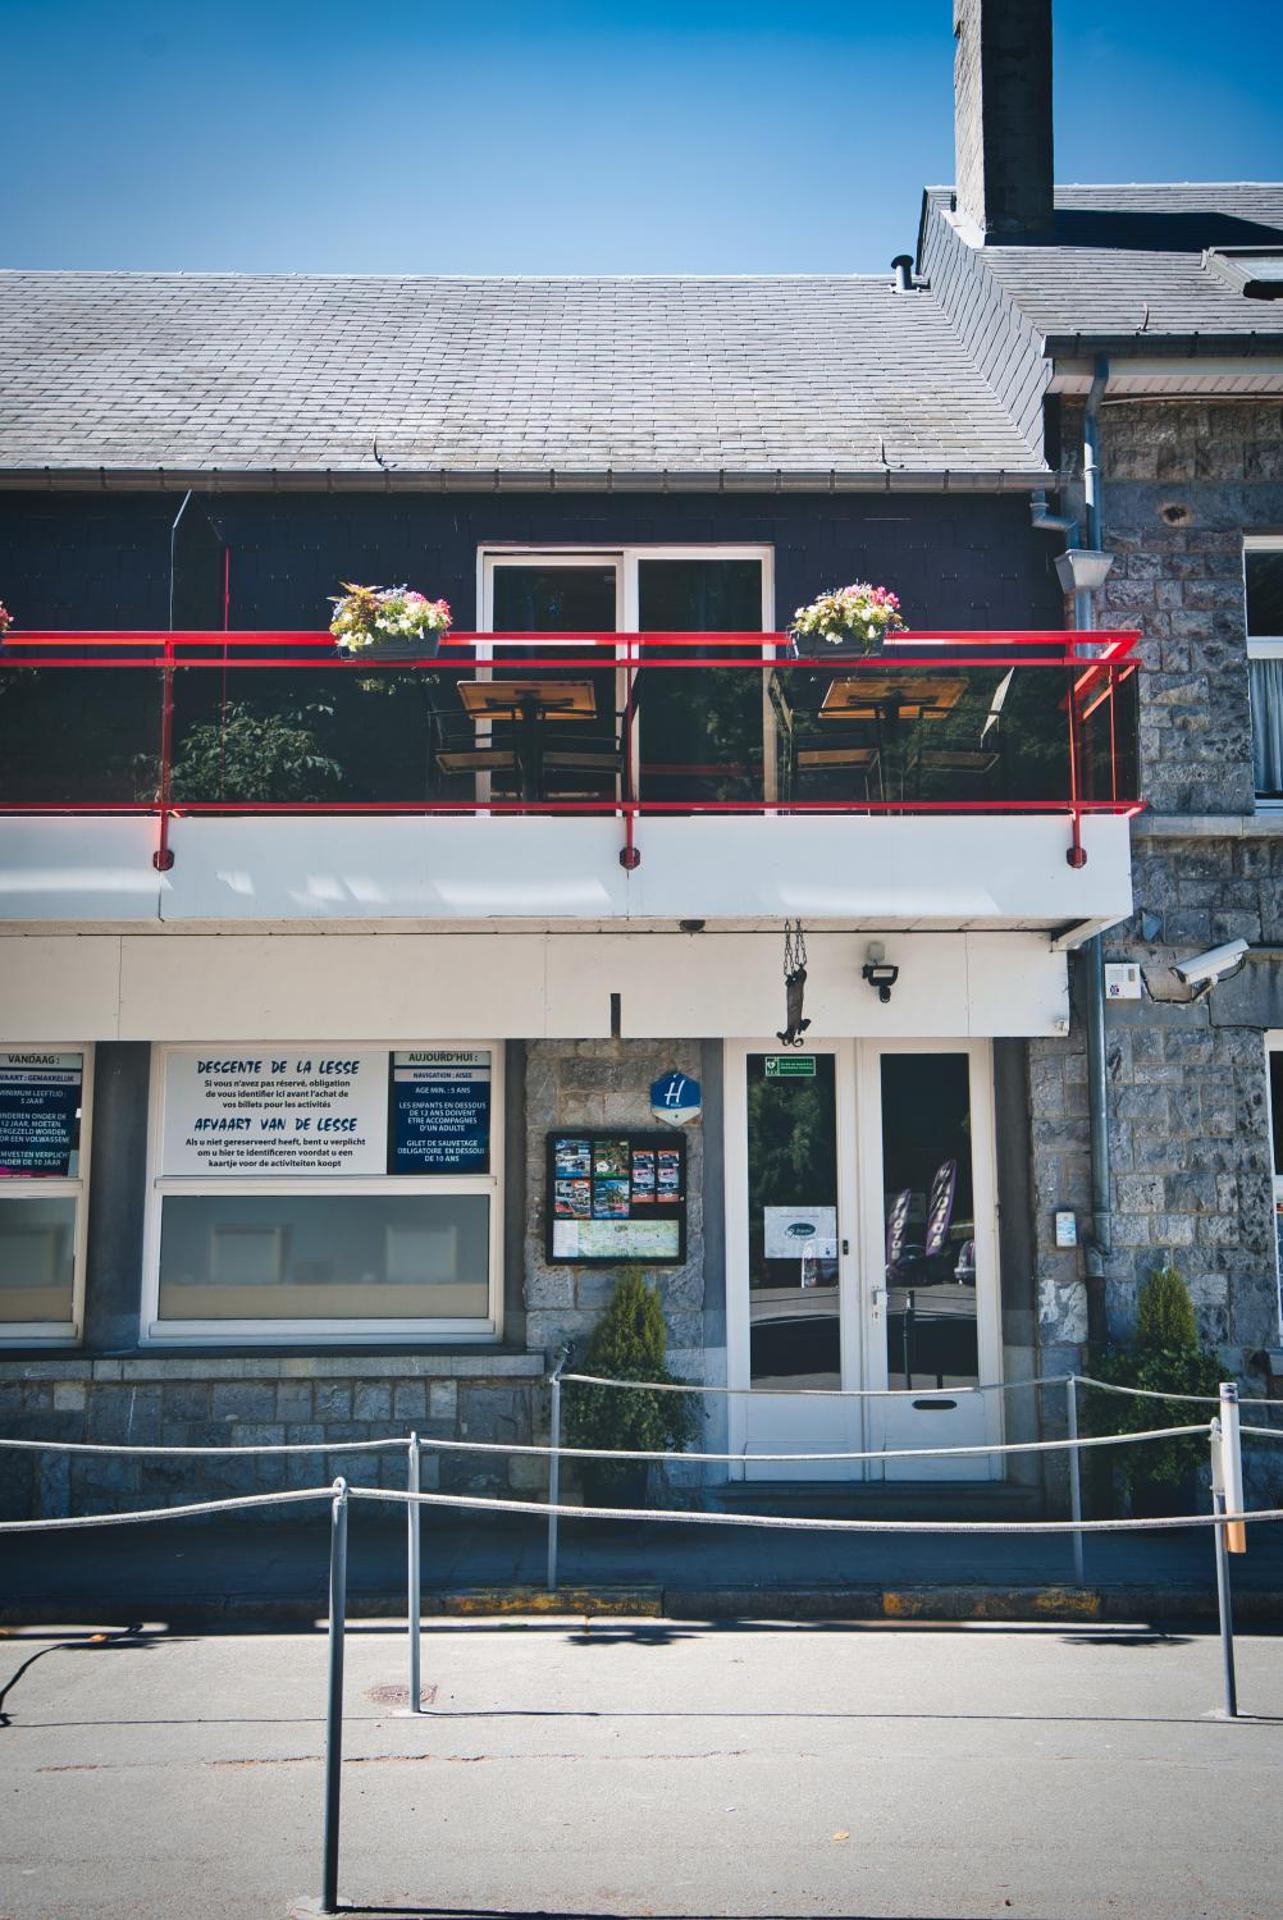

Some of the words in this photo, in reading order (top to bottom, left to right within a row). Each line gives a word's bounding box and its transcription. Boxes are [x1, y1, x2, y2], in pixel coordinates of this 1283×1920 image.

[7, 1054, 55, 1064] VANDAAG
[408, 1052, 473, 1062] AUJOURD'HUI
[197, 1060, 263, 1074] DESCENTE
[271, 1060, 287, 1074] DE
[296, 1060, 312, 1074] LA
[318, 1060, 360, 1075] LESSE
[413, 1071, 451, 1079] NAVIGATION
[204, 1079, 212, 1088] Si
[233, 1079, 259, 1087] n'avez
[260, 1081, 275, 1089] pas
[276, 1080, 308, 1088] réservé,
[309, 1079, 351, 1089] obligation
[205, 1090, 216, 1098] de
[237, 1089, 275, 1098] identifier
[275, 1090, 285, 1098] ici
[310, 1089, 337, 1098] l'achat
[338, 1090, 349, 1098] de
[664, 1079, 685, 1106] H
[237, 1100, 263, 1108] billets
[263, 1102, 283, 1110] pour
[284, 1100, 296, 1108] les
[297, 1100, 331, 1108] activités
[194, 1117, 252, 1131] AFVAART
[260, 1118, 286, 1131] VAN
[295, 1117, 311, 1131] DE
[317, 1117, 358, 1132] LESSE
[185, 1138, 198, 1146] Als
[206, 1138, 223, 1146] niet
[223, 1138, 277, 1148] gereserveerd
[278, 1138, 302, 1146] heeft,
[303, 1138, 322, 1146] bent
[330, 1138, 366, 1147] verplicht
[218, 1149, 235, 1157] hier
[236, 1149, 245, 1157] te
[246, 1148, 297, 1157] identificeren
[298, 1148, 330, 1157] voordat
[208, 1159, 238, 1169] kaartje
[258, 1159, 269, 1167] de
[270, 1159, 316, 1167] activiteiten
[317, 1159, 341, 1168] koopt
